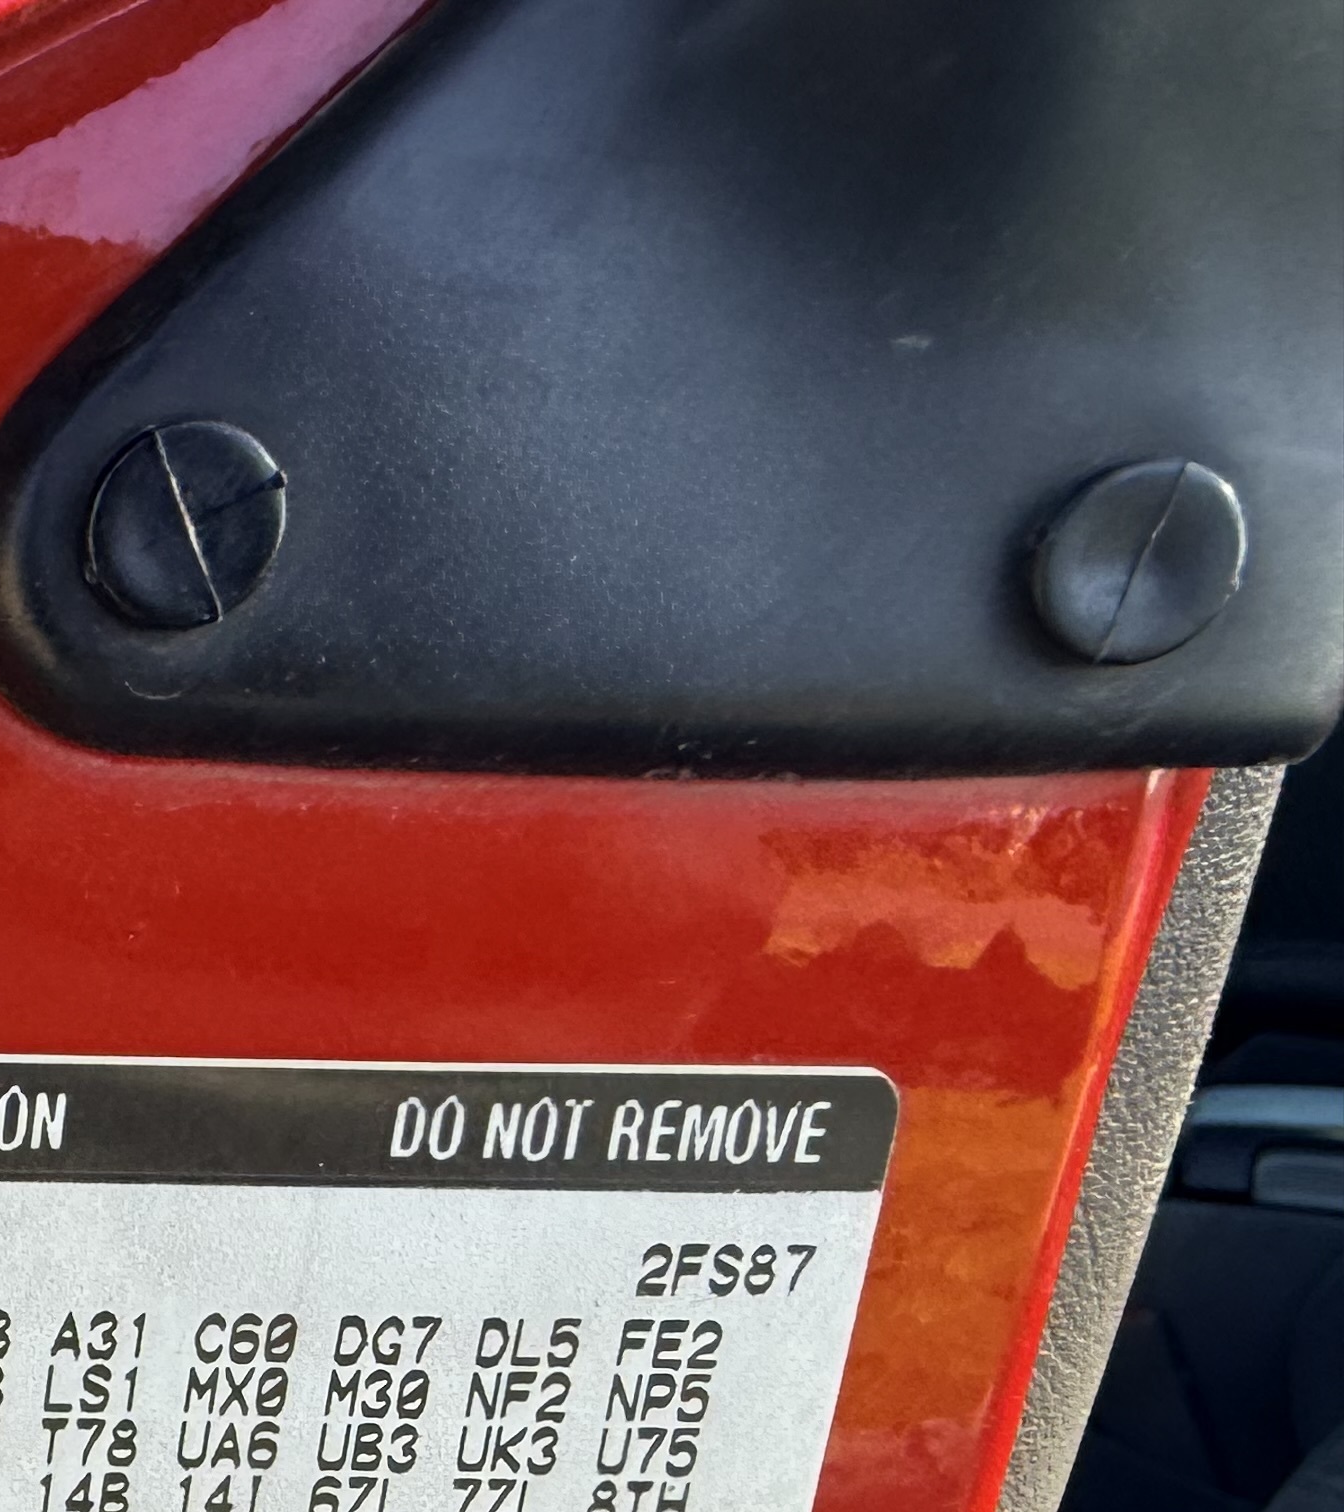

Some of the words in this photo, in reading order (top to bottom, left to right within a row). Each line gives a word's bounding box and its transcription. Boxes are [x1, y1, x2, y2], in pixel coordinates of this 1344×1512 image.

[391, 1095, 464, 1160] DO
[483, 1097, 594, 1161] NOT
[608, 1099, 831, 1164] REMOVE
[637, 1244, 816, 1296] 2FS87
[51, 1311, 145, 1360] A31
[196, 1313, 297, 1364] C60
[334, 1316, 442, 1366] DG7
[476, 1318, 581, 1368] DL5
[617, 1319, 722, 1371] FE2
[44, 1365, 137, 1412] LS1
[184, 1367, 288, 1417] MX0
[325, 1370, 429, 1419] M30
[466, 1372, 570, 1423] NF2
[606, 1374, 711, 1422] NP5
[42, 1418, 136, 1466] T78
[178, 1421, 279, 1470] UA6
[318, 1423, 418, 1473] UB3
[458, 1426, 558, 1475] UK3
[598, 1428, 699, 1477] U75
